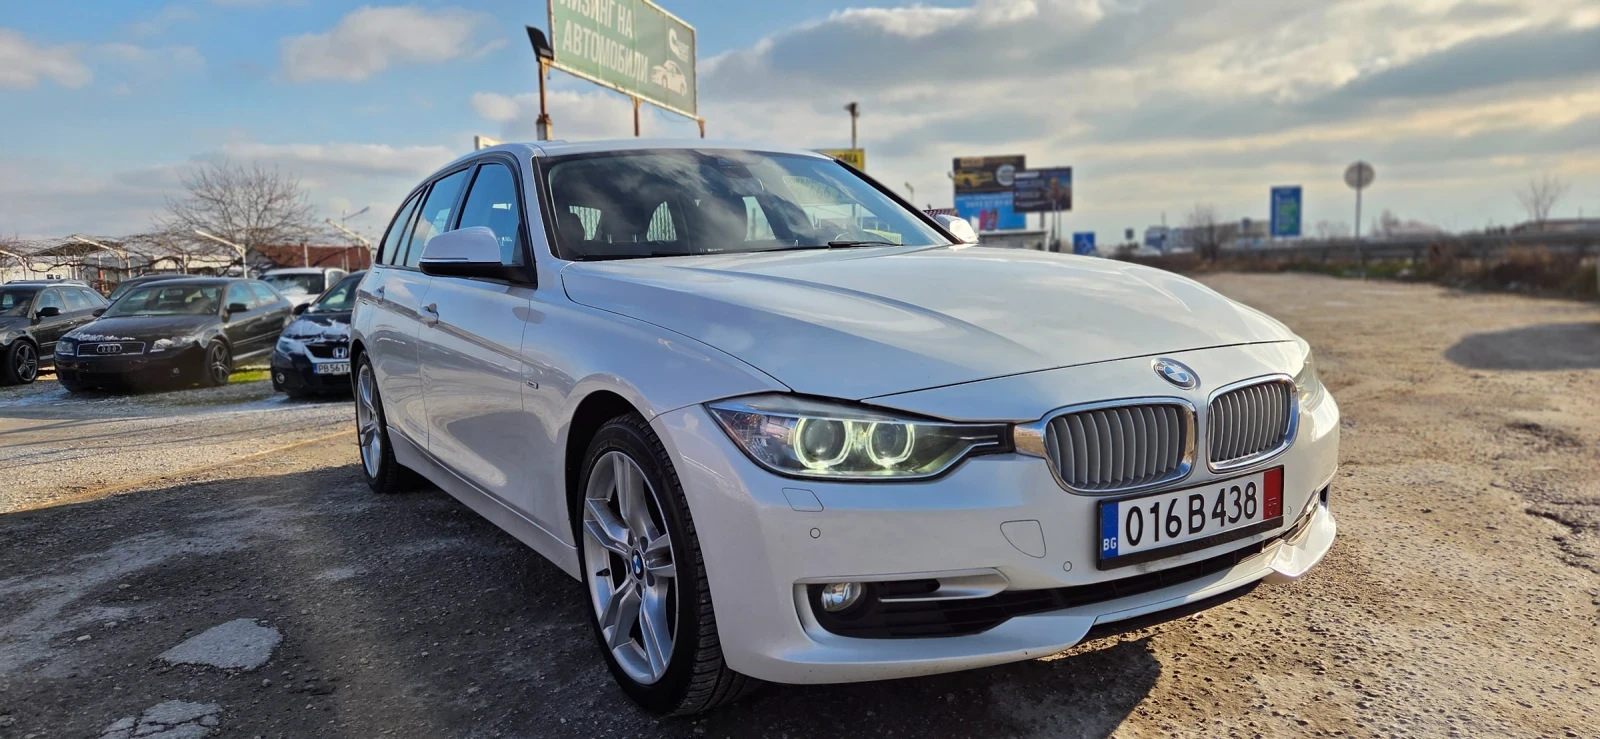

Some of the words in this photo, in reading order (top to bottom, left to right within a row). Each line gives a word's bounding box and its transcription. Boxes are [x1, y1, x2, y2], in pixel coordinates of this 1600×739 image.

[559, 0, 616, 28] ЗИНГ
[618, 3, 634, 39] НА
[562, 19, 649, 84] АВТОМОБИЛИ
[1103, 537, 1117, 551] BG
